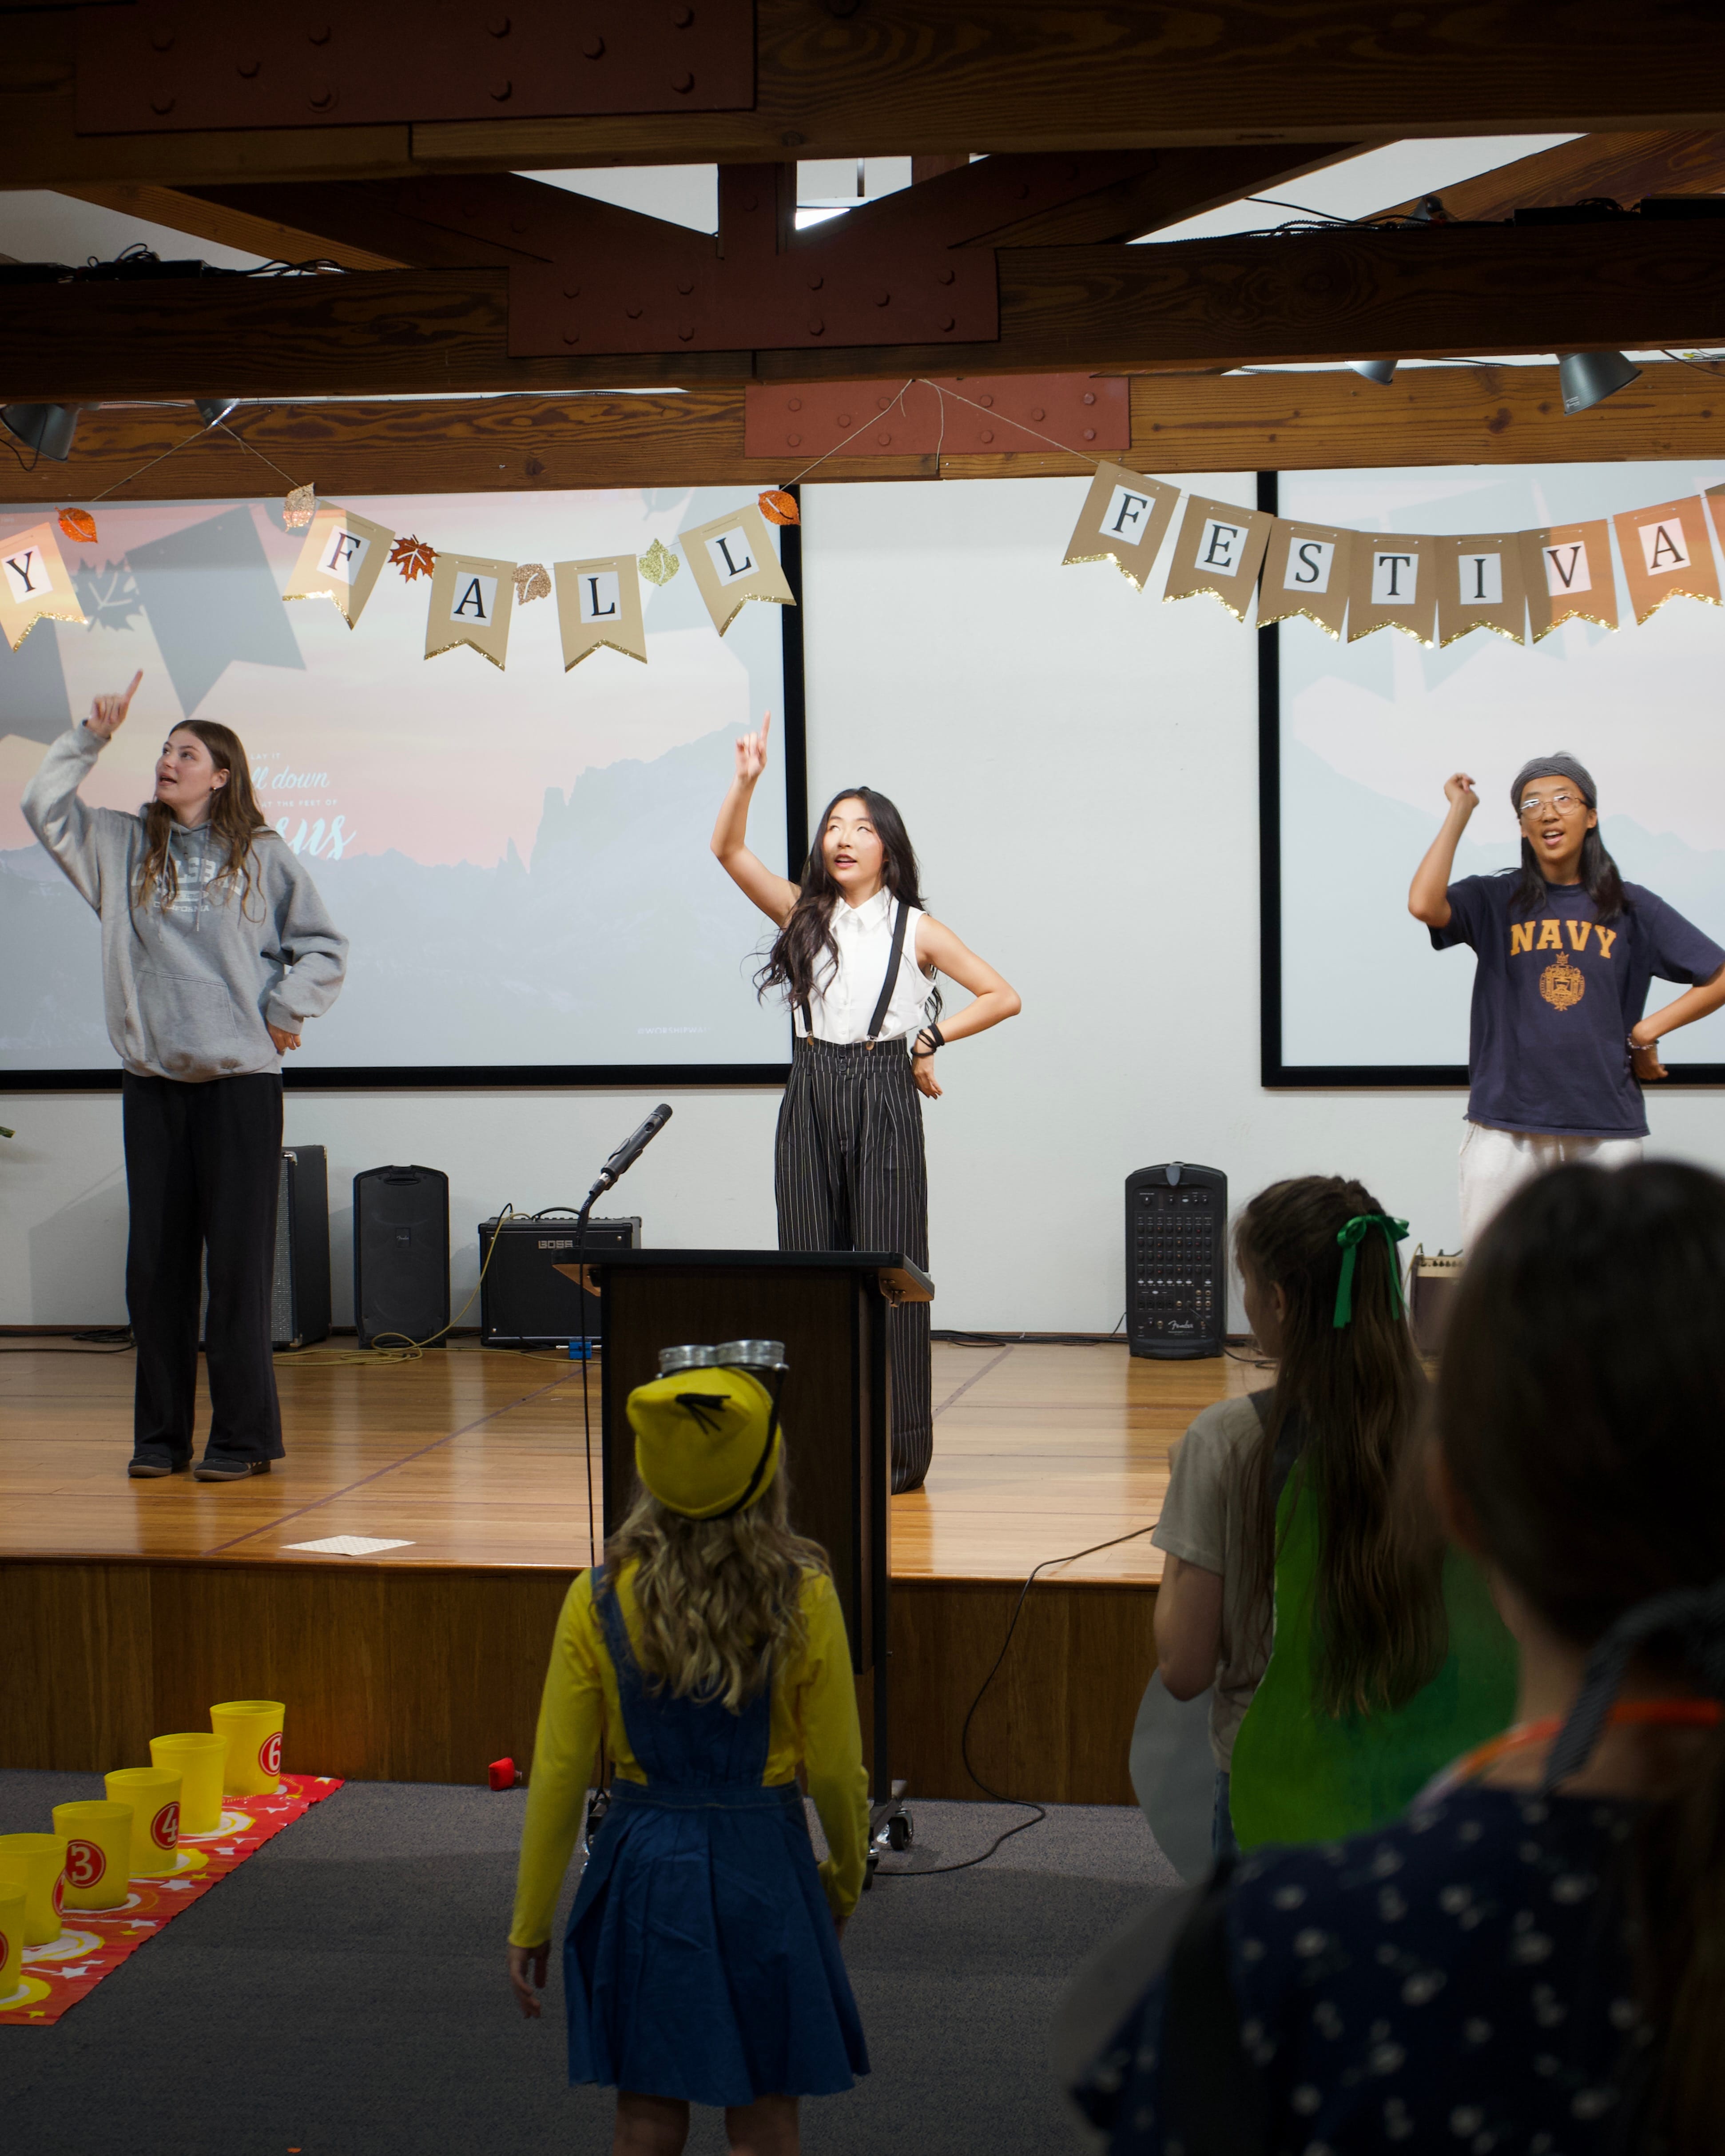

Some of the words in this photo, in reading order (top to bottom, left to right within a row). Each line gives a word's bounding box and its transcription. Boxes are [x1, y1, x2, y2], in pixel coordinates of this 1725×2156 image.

[326, 532, 752, 620] FALL
[1111, 493, 1685, 599] FESTIVA
[252, 766, 269, 790] ll
[272, 765, 330, 790] down
[1510, 919, 1617, 959] NAVY
[538, 1240, 573, 1249] BOSS
[268, 1737, 281, 1771] 6
[161, 1807, 178, 1842] 4
[71, 1846, 93, 1883] 3
